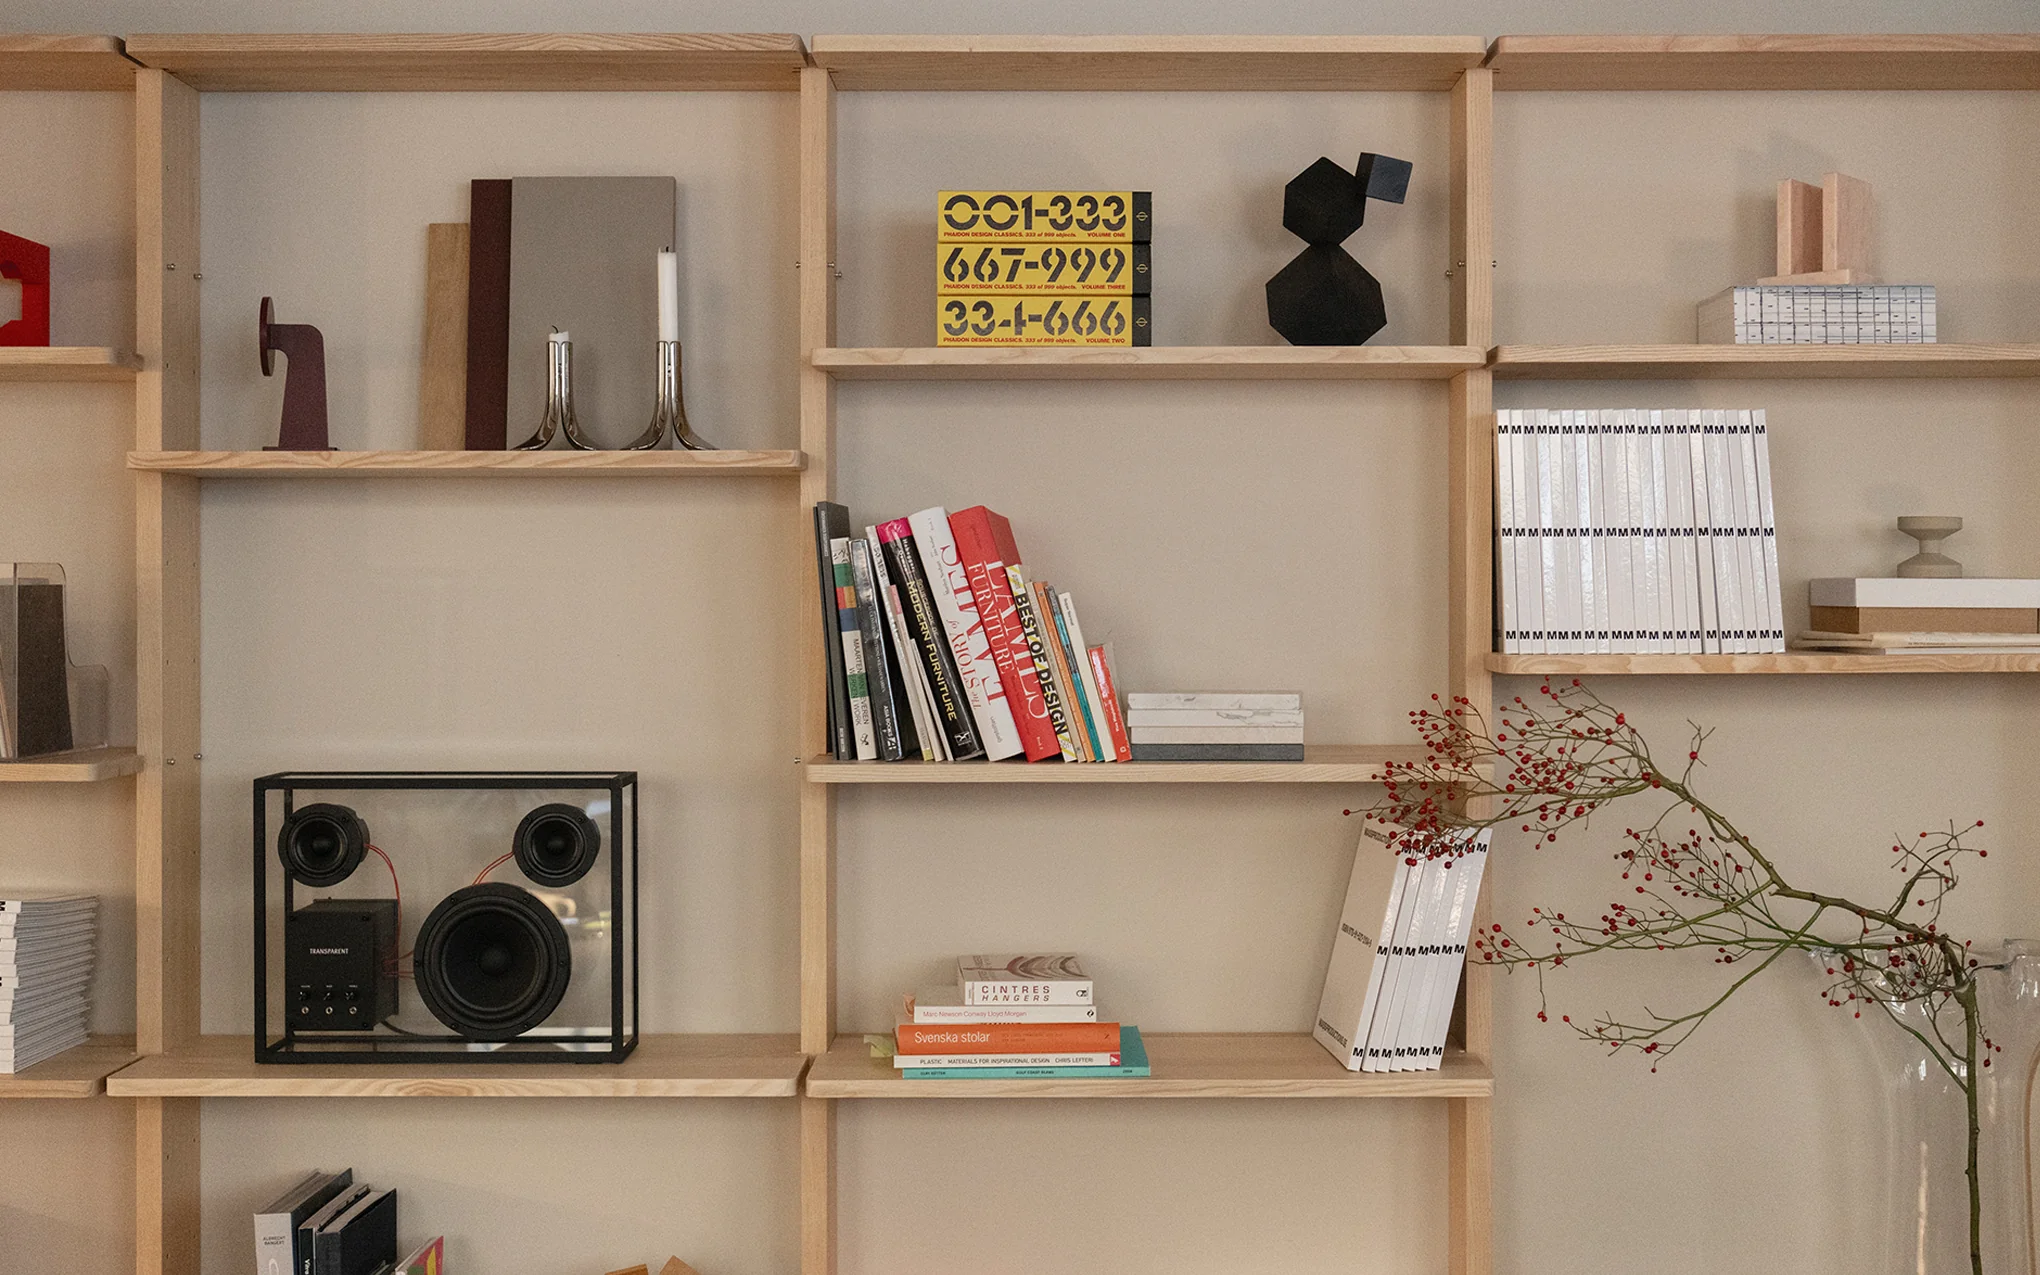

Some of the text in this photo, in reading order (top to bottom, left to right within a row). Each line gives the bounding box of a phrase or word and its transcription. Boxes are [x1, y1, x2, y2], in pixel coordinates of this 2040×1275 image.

[943, 194, 1127, 232] 001-333
[943, 247, 1126, 284] 667-999
[943, 299, 1126, 337] 334-666
[1498, 425, 1766, 435] M M M M M M M M M M M M M M M M M M M M M
[1501, 528, 1774, 538] M M M M M M M M M M M M M M M M M M M M M
[968, 562, 1015, 674] FURNITURE
[1014, 593, 1040, 637] BEST
[983, 560, 1049, 718] EAMES
[1505, 630, 1783, 640] M M M M M M M M M M M M M M M M M M M M M
[853, 638, 864, 674] MAARTEN
[907, 581, 957, 721] MODERN FURNITURE
[1029, 641, 1049, 663] OF
[946, 619, 982, 709] The STORY of
[1038, 668, 1068, 735] DESIGN
[1476, 842, 1487, 852] M
[309, 947, 349, 955] TRANSPARENT
[1376, 944, 1466, 957] M M M M M M M
[981, 985, 1050, 994] CINTRES
[981, 994, 1050, 1002] HANGERS
[914, 1031, 991, 1043] Svenska stolar
[1352, 1046, 1443, 1059] M M M M M M M
